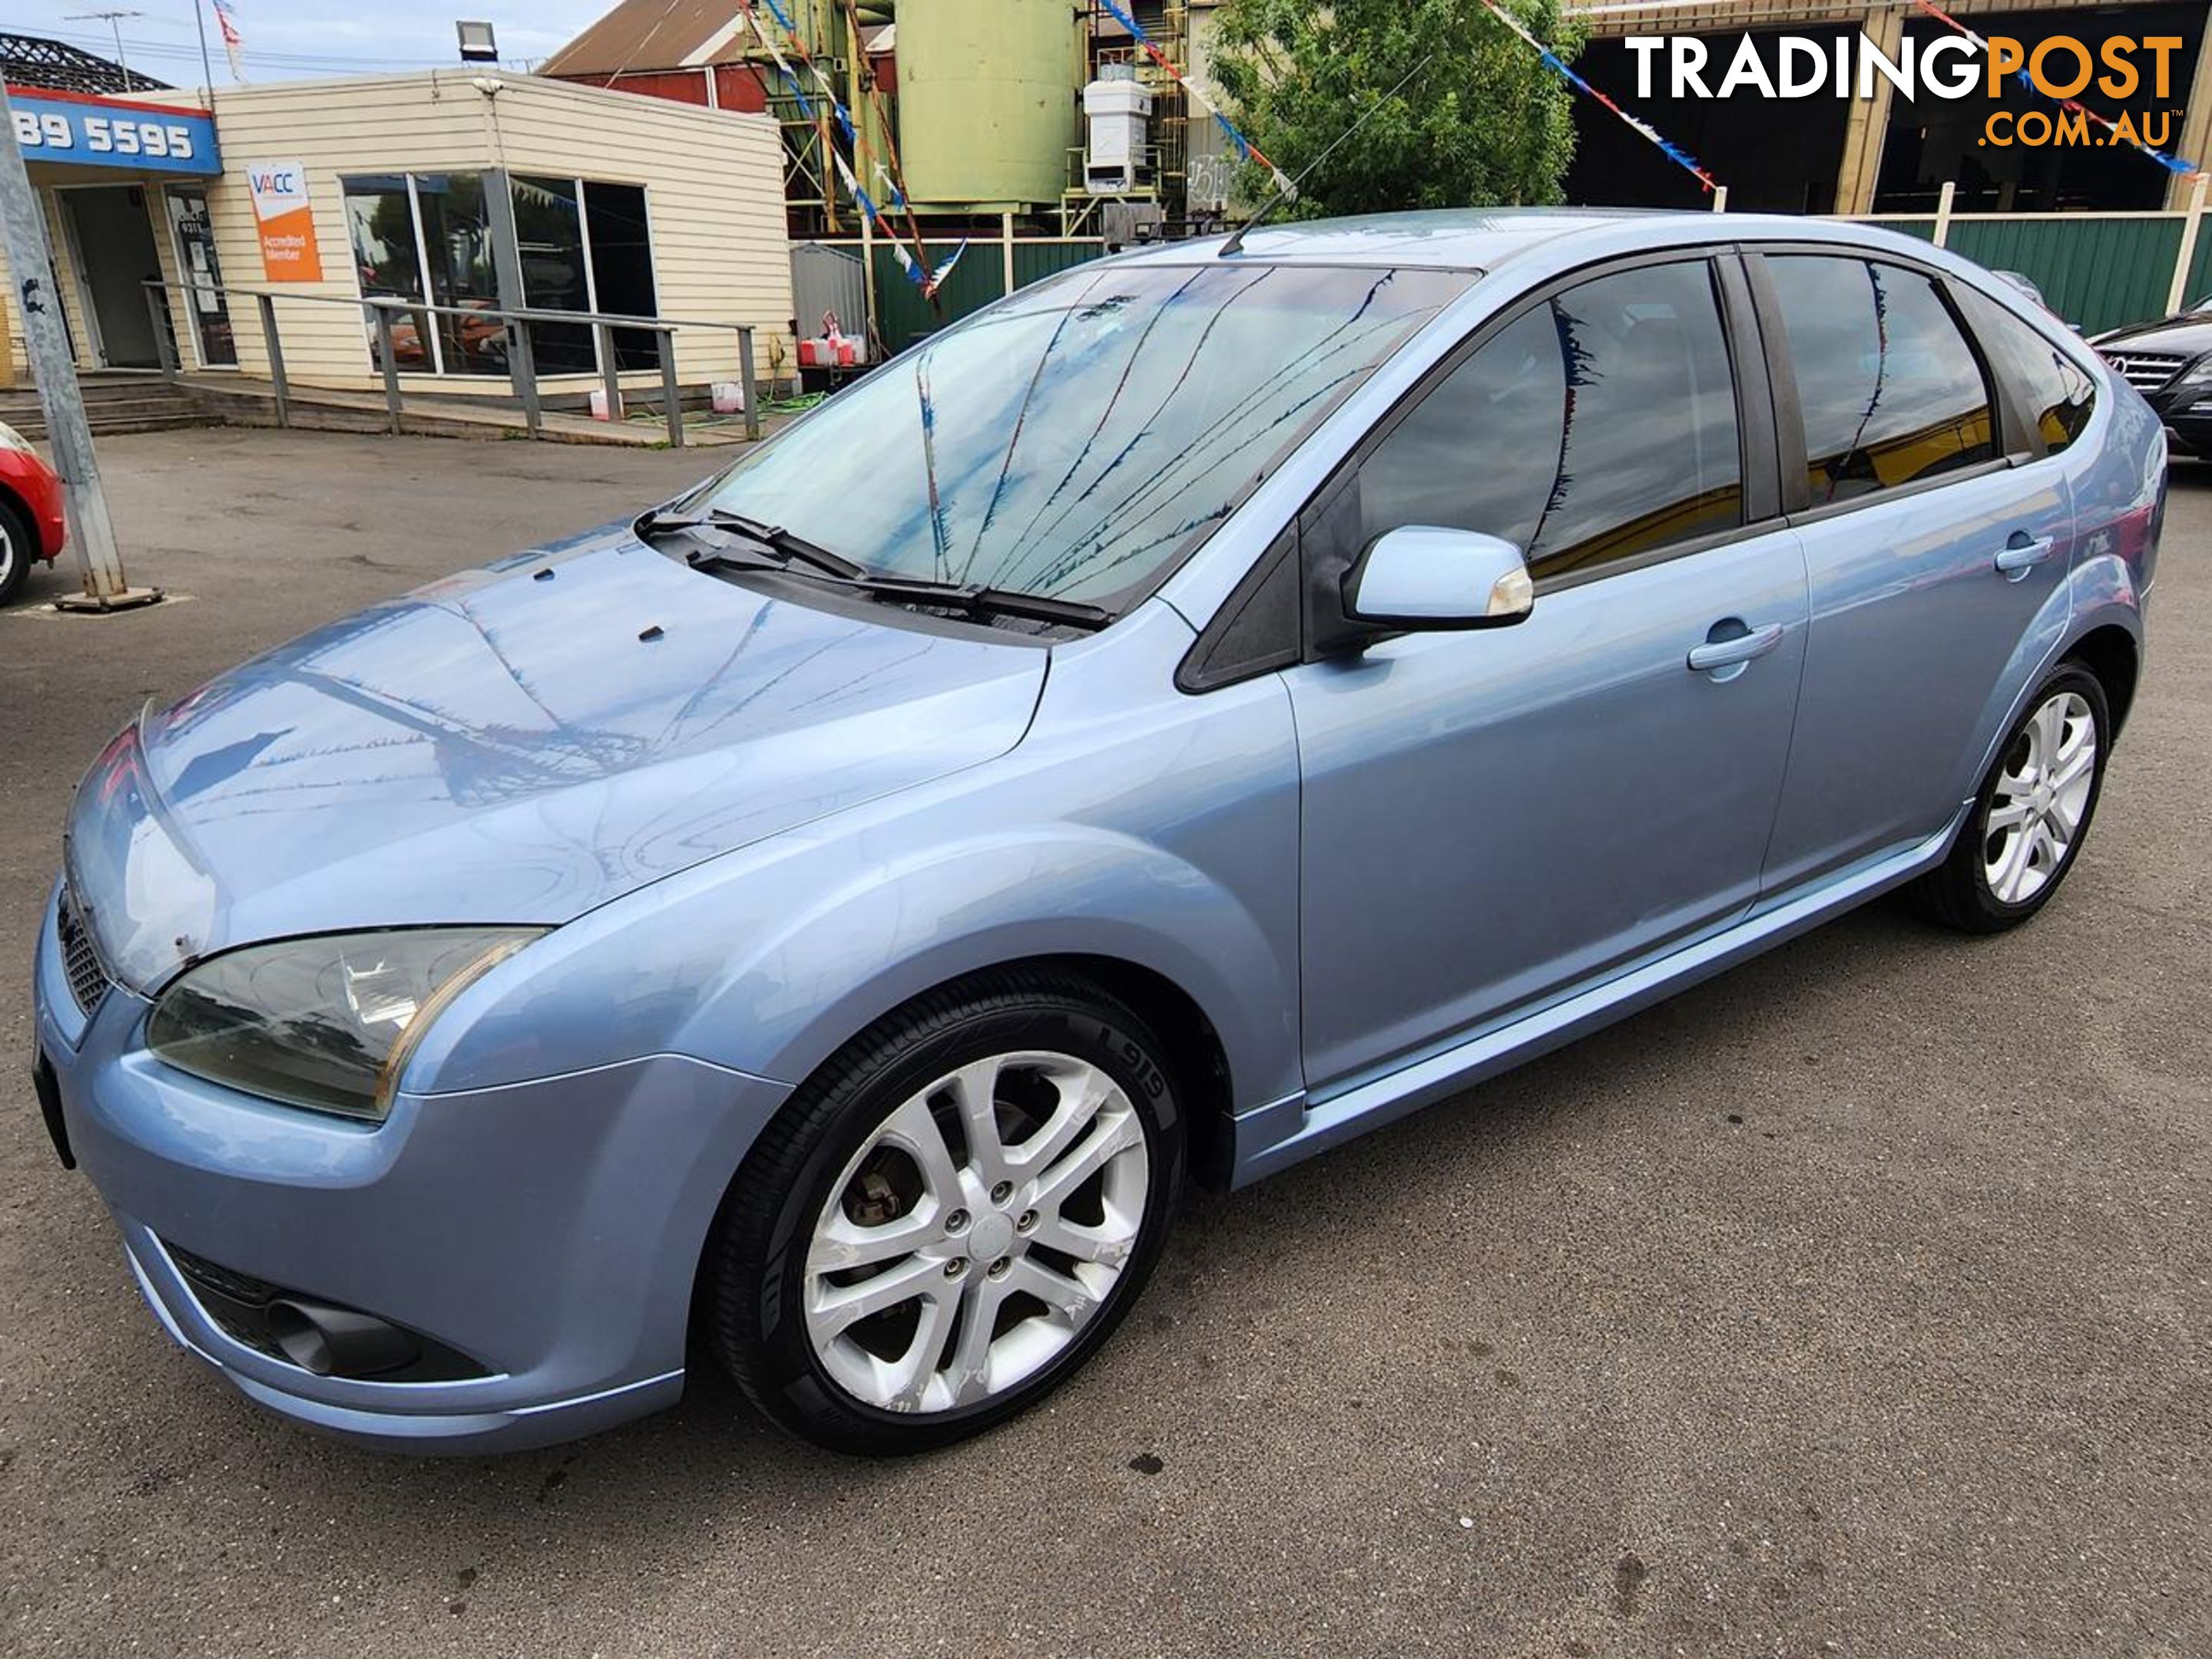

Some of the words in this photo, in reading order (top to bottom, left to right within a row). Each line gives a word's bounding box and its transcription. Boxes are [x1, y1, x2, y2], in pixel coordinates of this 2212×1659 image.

[84, 118, 194, 159] 5595
[252, 173, 293, 194] VACC
[263, 234, 306, 248] Accredited
[265, 248, 300, 261] Member
